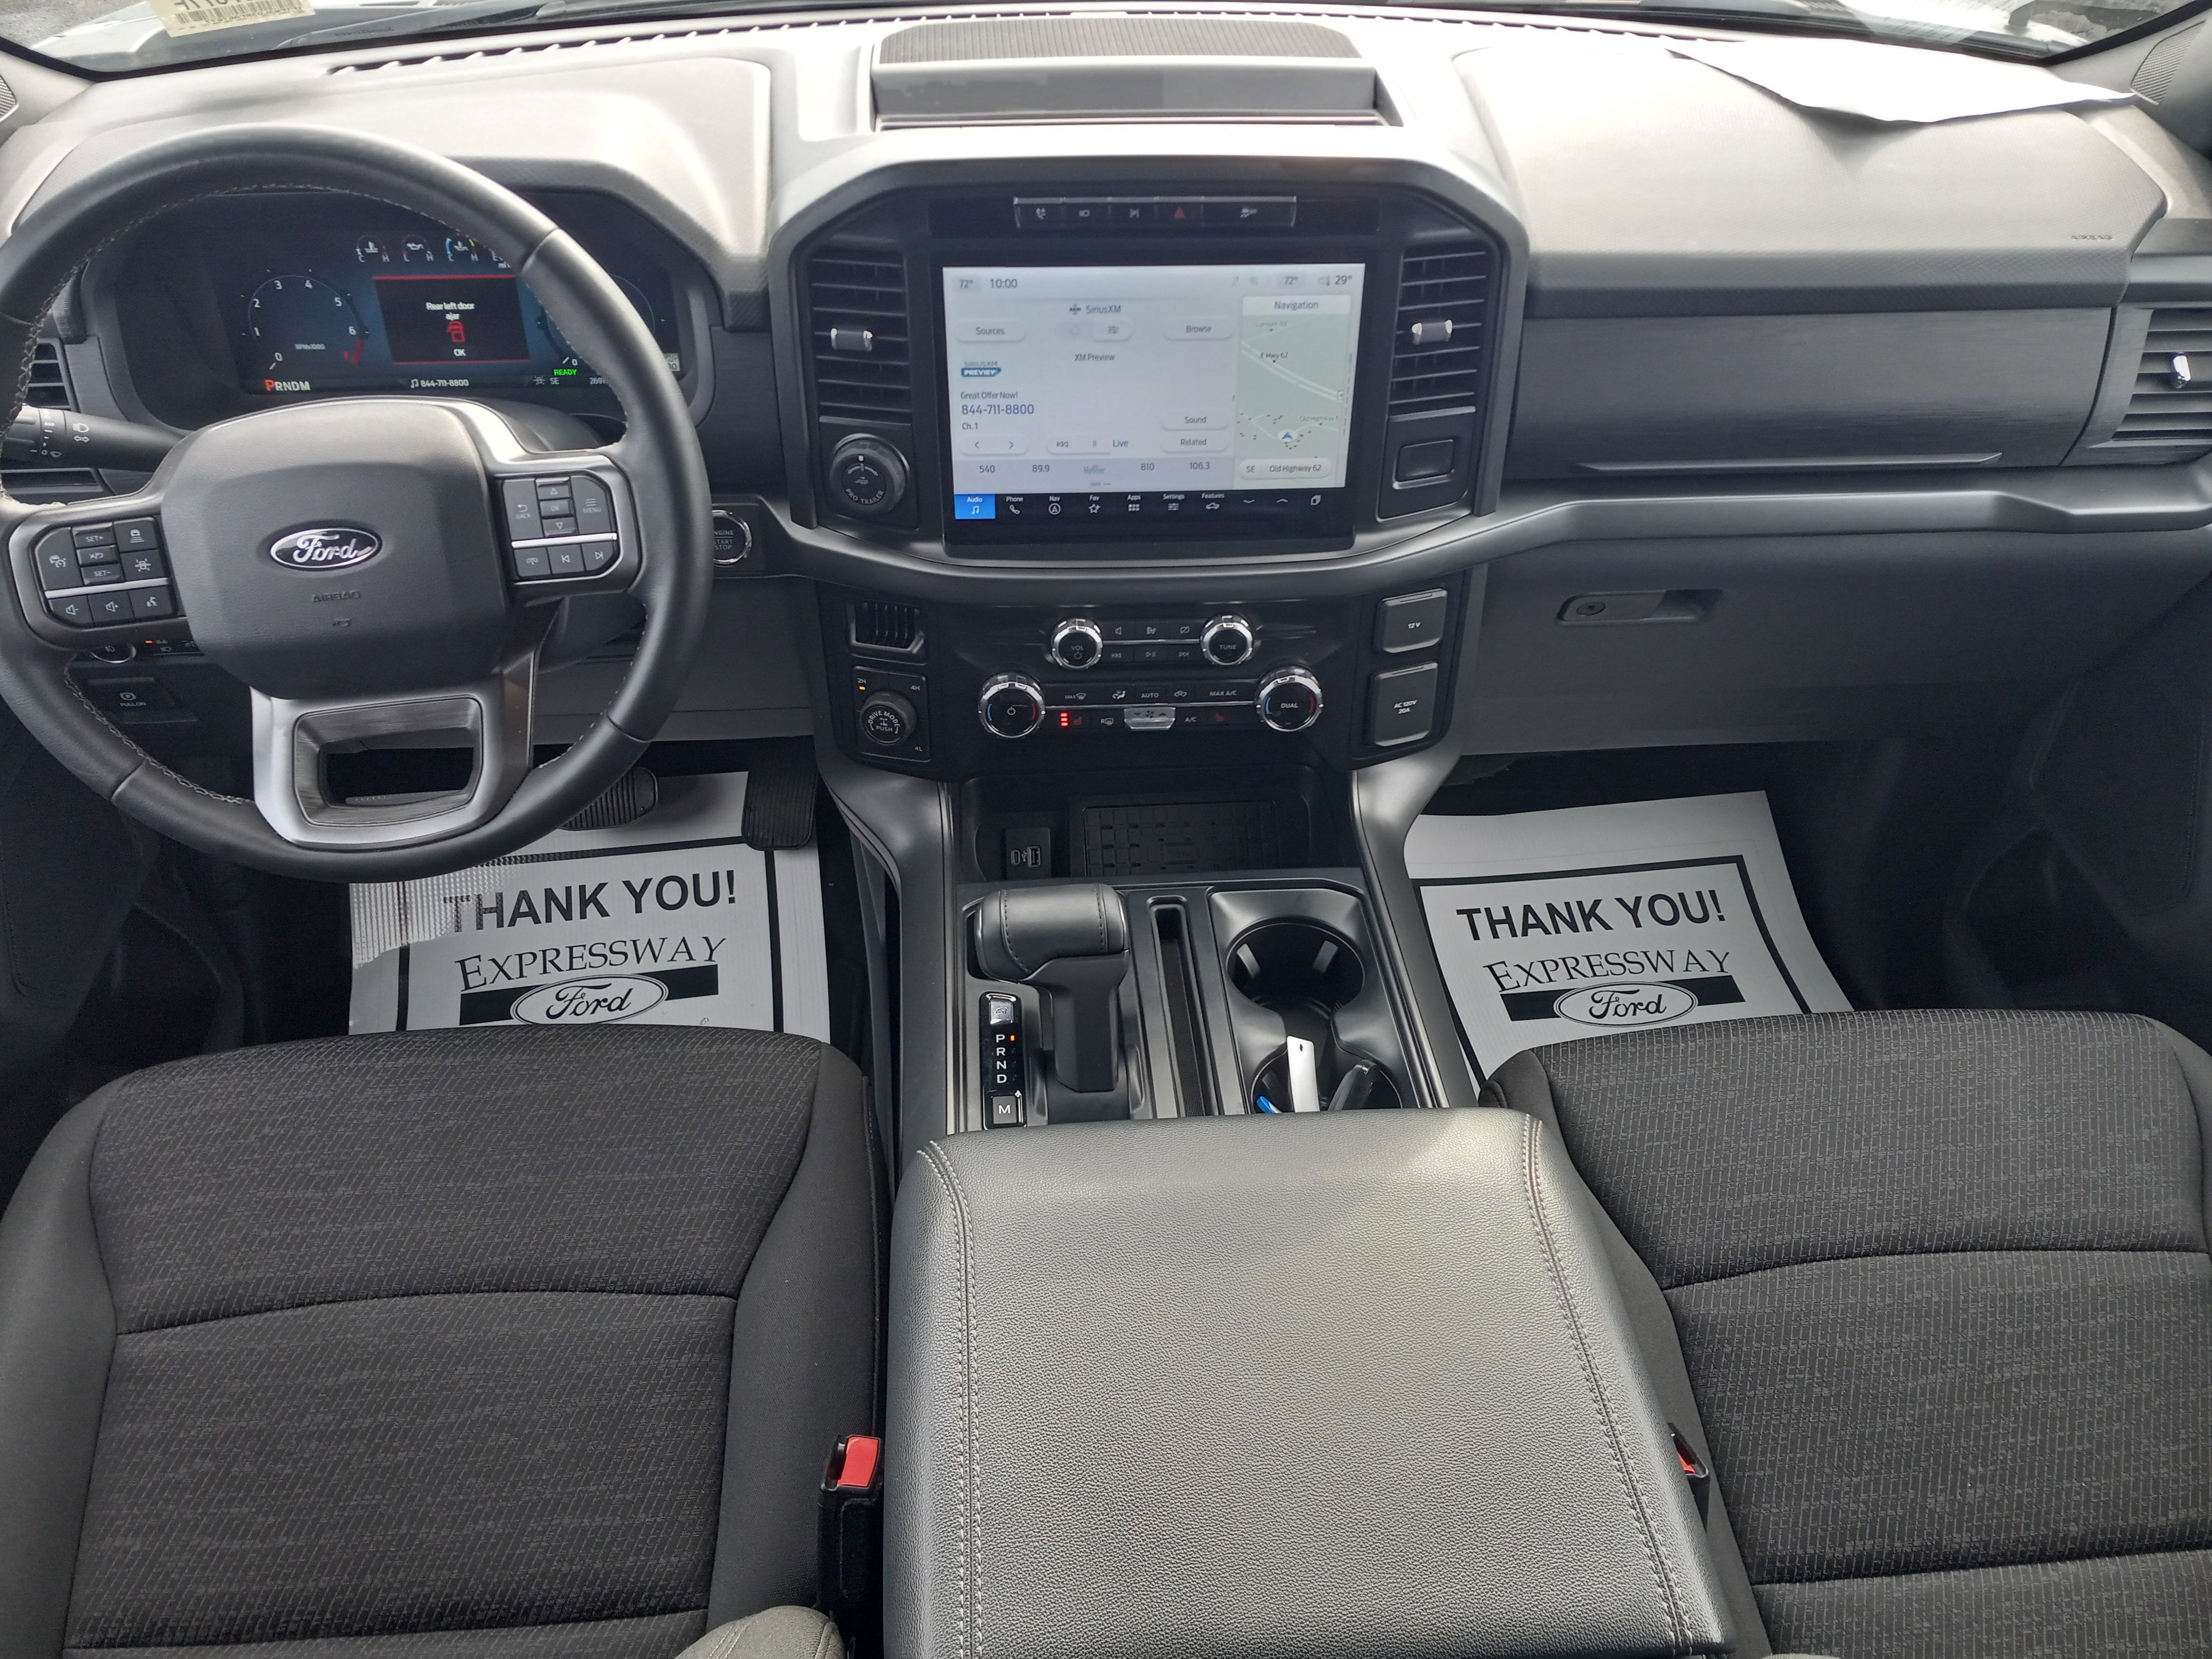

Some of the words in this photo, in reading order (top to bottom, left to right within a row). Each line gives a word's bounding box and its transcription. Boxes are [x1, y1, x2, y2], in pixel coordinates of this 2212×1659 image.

[274, 280, 282, 289] 3
[305, 280, 313, 289] 4
[990, 279, 1018, 289] 10:00
[1334, 275, 1352, 285] 29°
[253, 299, 261, 308] 2
[335, 297, 342, 306] 5
[1274, 301, 1319, 310] Navigation
[426, 302, 443, 311] Rear
[444, 302, 457, 310] left
[457, 302, 475, 310] door
[1086, 305, 1121, 314] SiriusXM
[445, 313, 460, 321] ajar
[254, 327, 260, 336] 1
[349, 326, 356, 335] 6
[975, 327, 1005, 336] Sources
[275, 352, 283, 361] 0
[962, 404, 1034, 415] 844-711-8800
[1184, 416, 1206, 424] Sound
[1113, 440, 1129, 448] Live
[1180, 438, 1207, 446] Related
[979, 465, 995, 473] 540
[1032, 464, 1050, 473] 89.9
[1141, 463, 1154, 471] 810
[1190, 462, 1210, 470] 106.3
[1246, 465, 1255, 473] SE
[1269, 464, 1281, 473] Old
[1282, 464, 1311, 473] Highway
[1313, 464, 1322, 472] 62
[845, 488, 858, 502] PRO
[860, 490, 884, 505] TRAILER
[292, 533, 361, 563] Ford
[868, 710, 883, 725] DRIVE
[884, 710, 900, 727] MODE
[443, 882, 611, 933] THANK
[622, 869, 736, 914] YOU!
[1456, 899, 1614, 941] THANK
[1615, 890, 1726, 928] YOU!
[545, 983, 632, 1020] Ford
[1588, 989, 1667, 1020] Ford
[996, 1034, 1005, 1043] P
[997, 1047, 1006, 1056] R
[997, 1060, 1007, 1070] N
[997, 1074, 1007, 1083] D
[998, 1105, 1011, 1114] M
